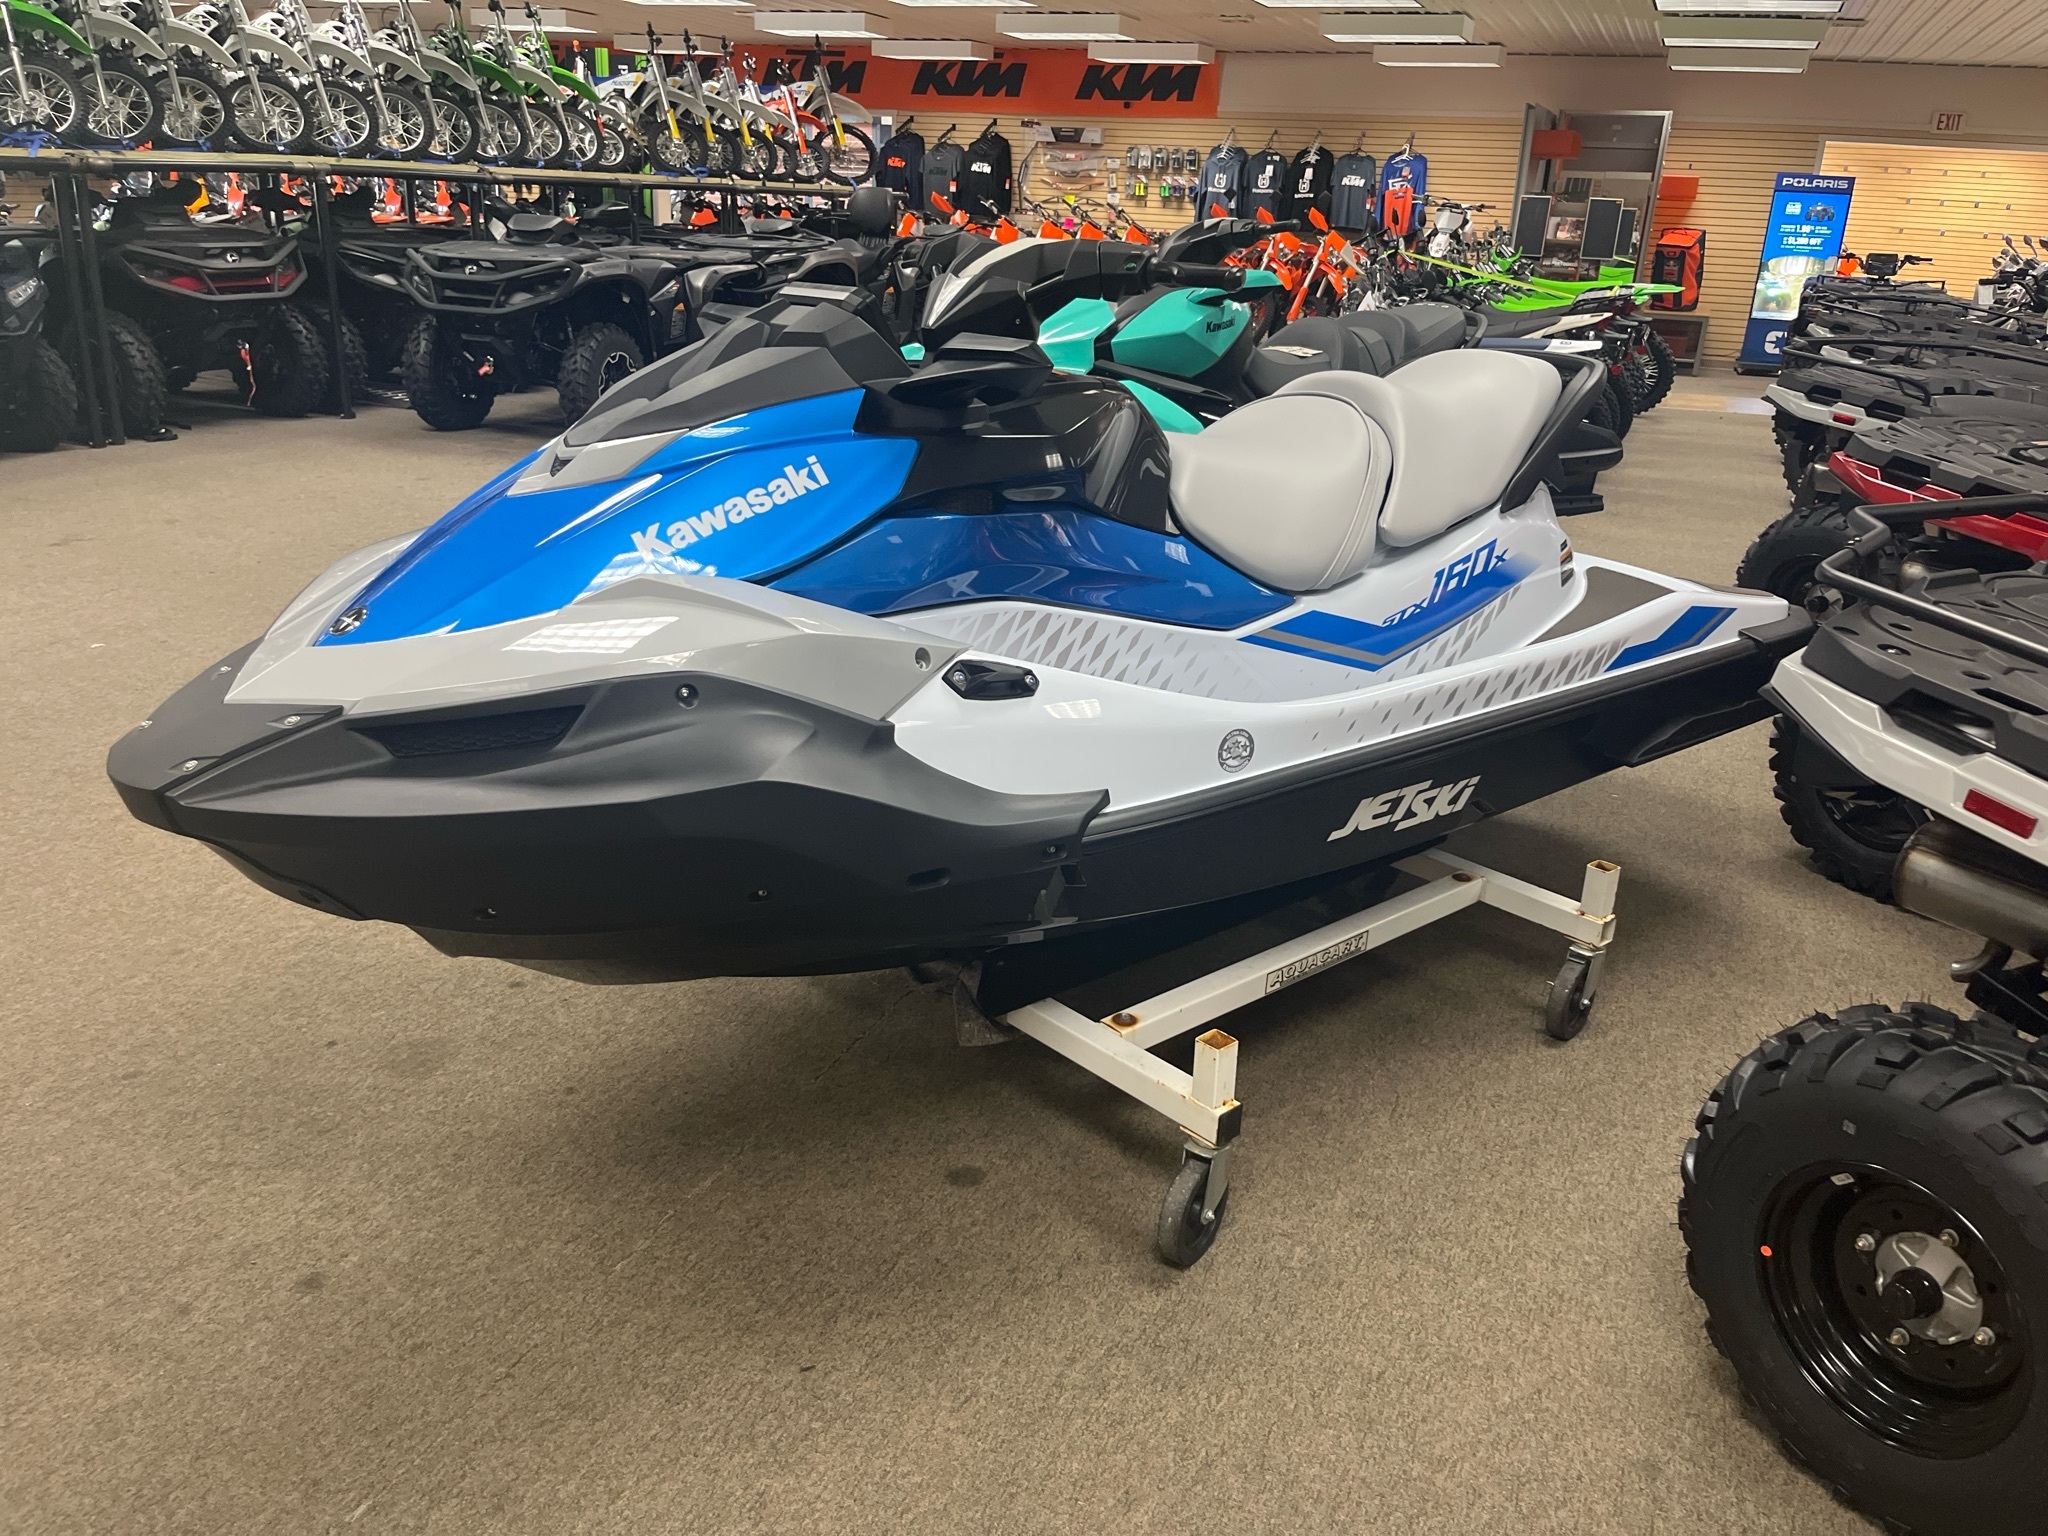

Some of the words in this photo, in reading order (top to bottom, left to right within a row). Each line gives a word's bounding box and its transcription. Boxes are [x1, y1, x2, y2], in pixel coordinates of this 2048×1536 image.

[911, 53, 1028, 98] KTM
[1075, 62, 1200, 102] KTM
[1936, 113, 1963, 131] EXIT
[970, 161, 992, 174] KTM
[1341, 174, 1365, 188] KTM
[1781, 177, 1849, 189] POLARIS
[630, 455, 830, 564] Kawasaki
[1269, 935, 1364, 988] AQUACART
